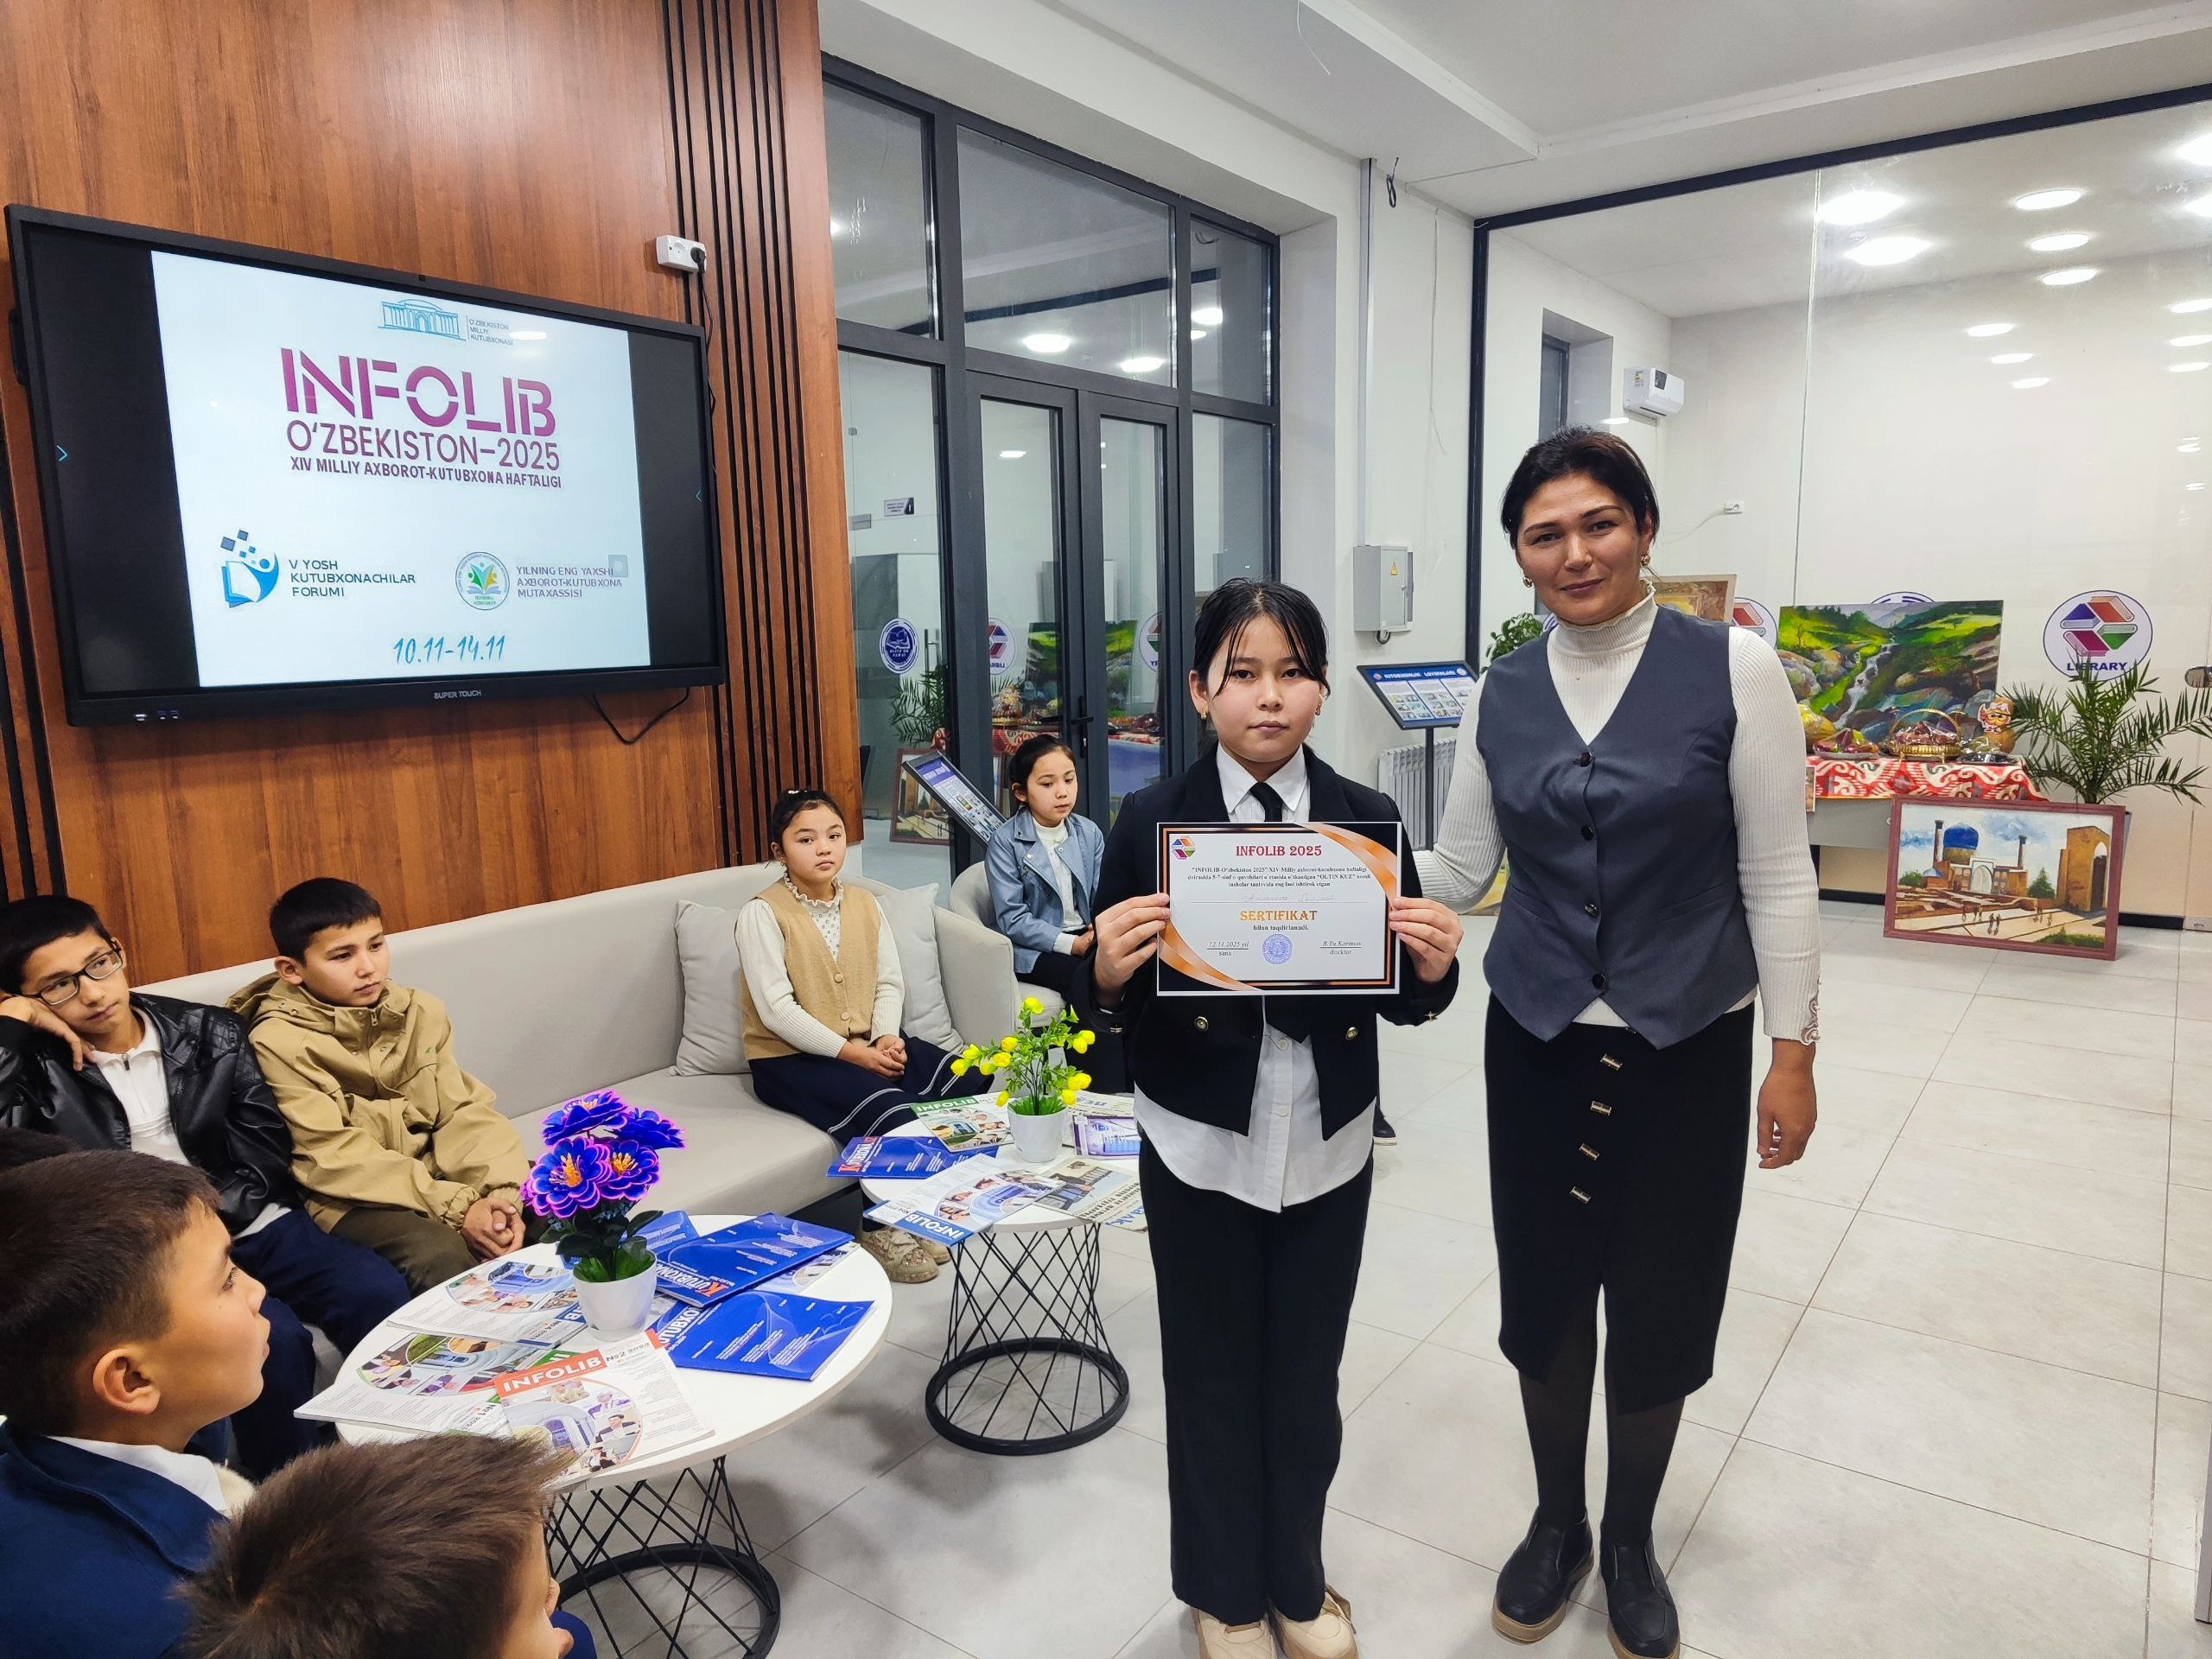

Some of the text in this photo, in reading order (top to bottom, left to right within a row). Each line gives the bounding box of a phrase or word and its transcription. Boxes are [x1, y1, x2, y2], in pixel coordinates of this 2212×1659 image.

[281, 347, 556, 437] INFOLIB
[290, 456, 562, 488] XIV MILLIY AXBOROT-KUTUBXONA HAFTALIGI
[289, 559, 339, 570] V YOSH
[516, 566, 613, 576] YILNING ENG YAXSHI
[290, 573, 416, 583] KUTUBXONACHILAR
[518, 578, 622, 588] AXBOROT-KUTUBXONA
[292, 587, 345, 597] FORUMI
[393, 635, 505, 664] 10.11-14.11
[434, 691, 457, 700] SUPER
[1236, 844, 1322, 856] INFOLIB 2025
[1240, 910, 1318, 921] SERTIFIKAT
[917, 1098, 976, 1112] INFOLIB
[905, 1213, 964, 1239] INFOLIB
[503, 1357, 602, 1393] INFOLIB
